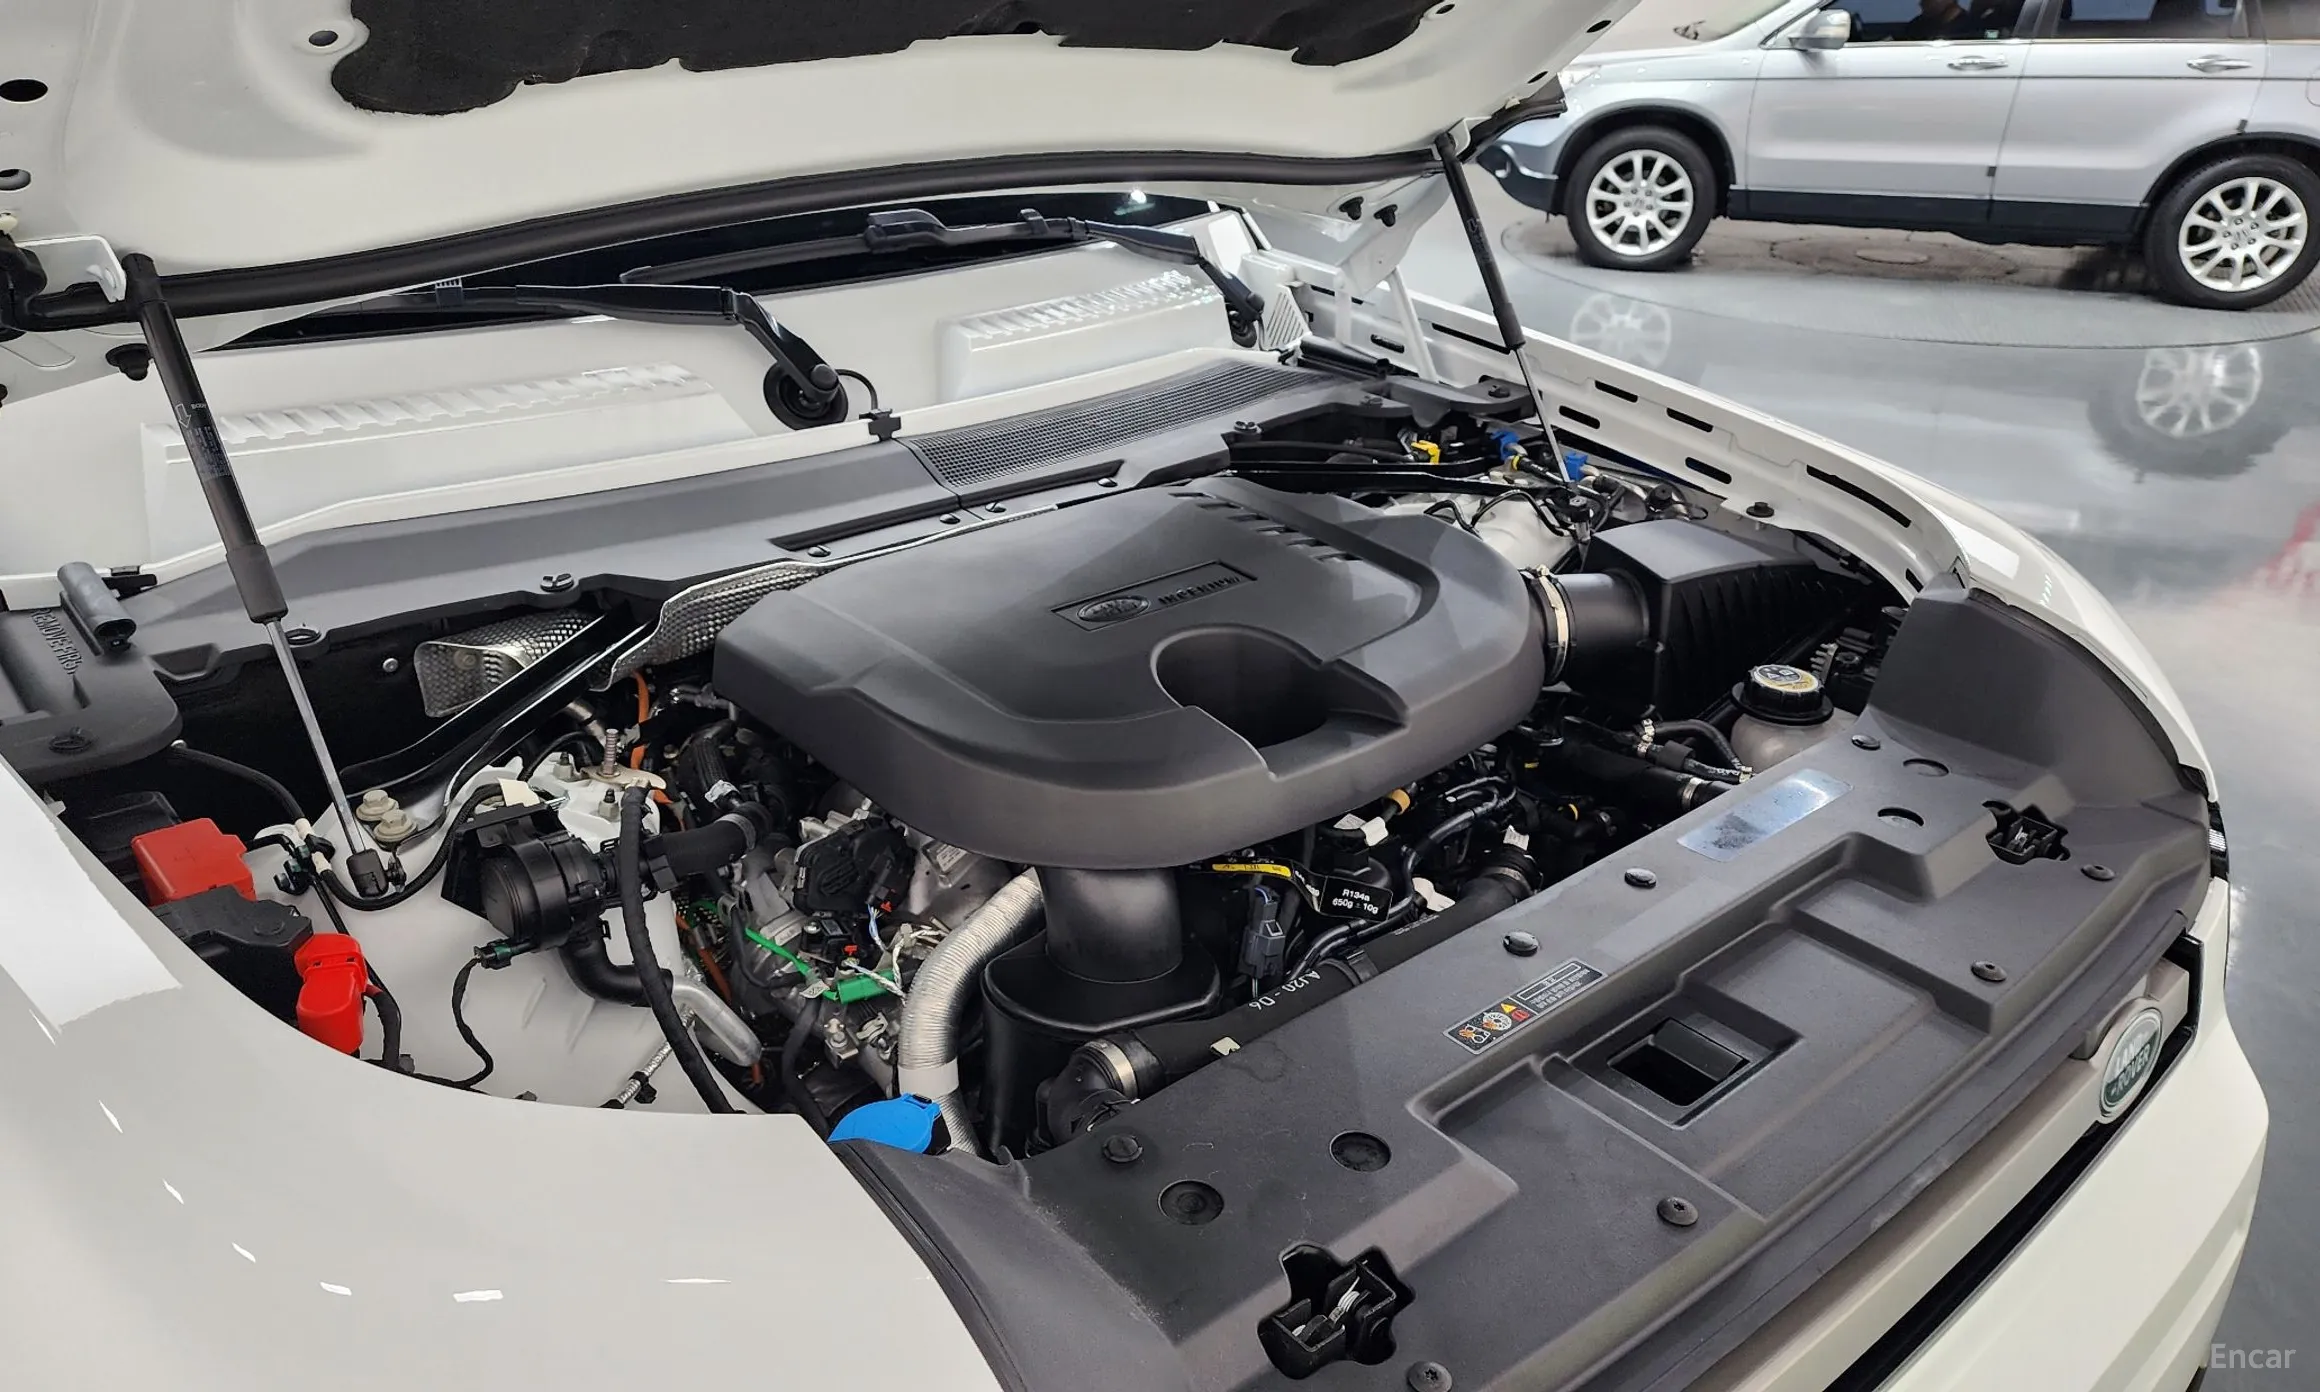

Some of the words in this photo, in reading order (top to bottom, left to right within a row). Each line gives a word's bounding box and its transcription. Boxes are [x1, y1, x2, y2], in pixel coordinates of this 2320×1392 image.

[1342, 888, 1370, 902] R134a
[1332, 897, 1353, 909] 650g
[1363, 902, 1379, 914] 10g
[1249, 996, 1276, 1010] D6
